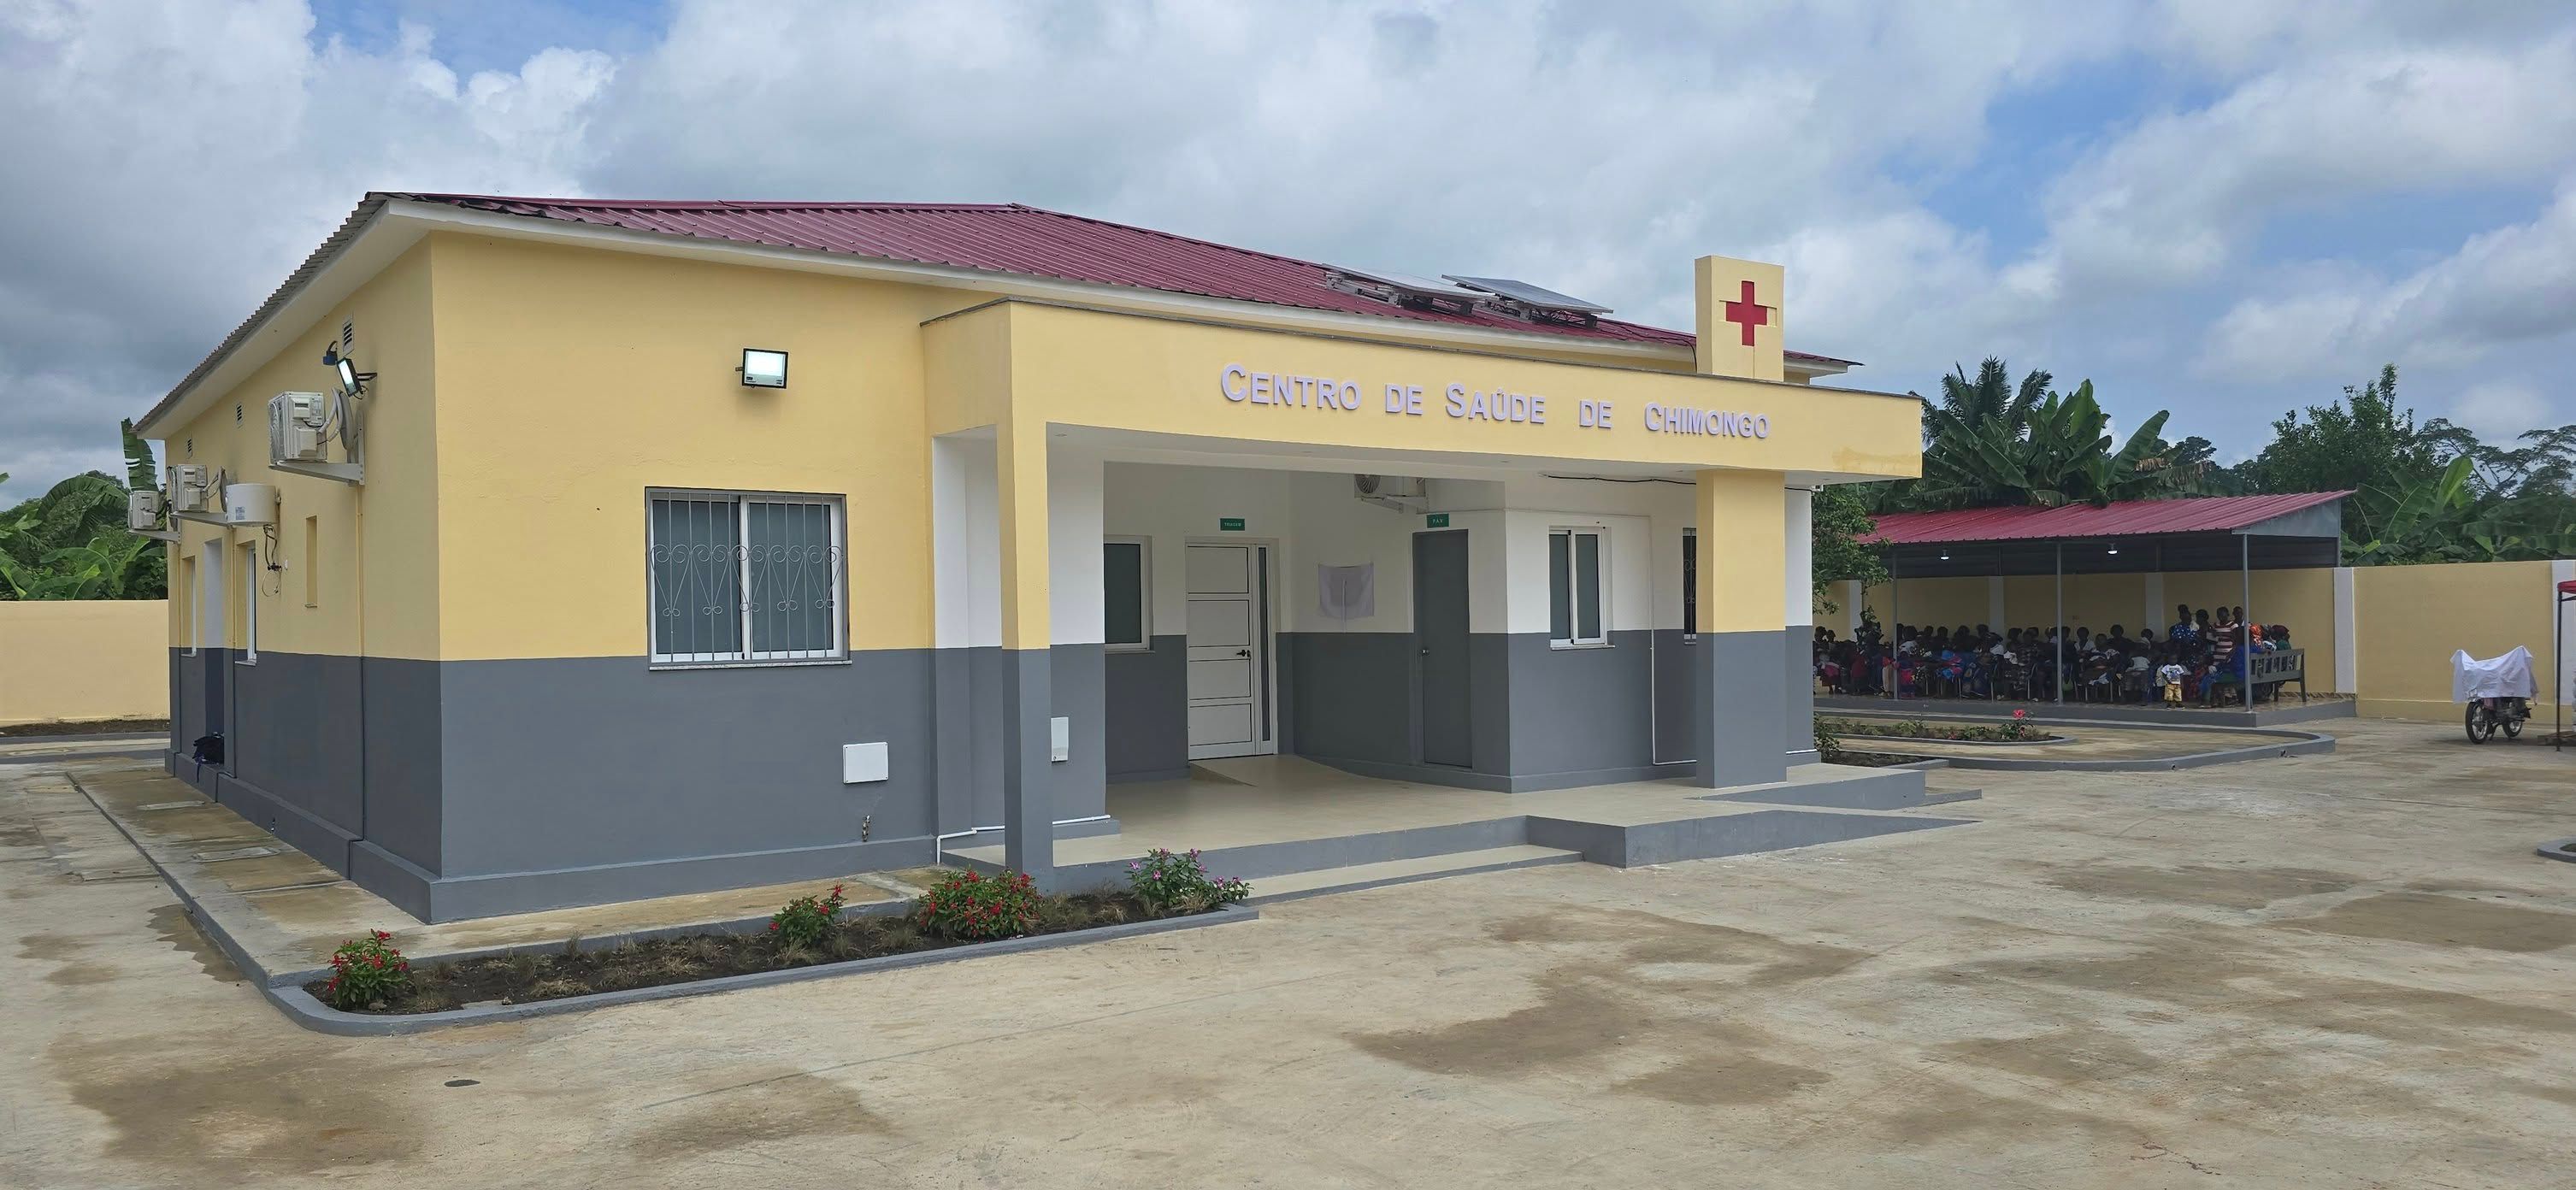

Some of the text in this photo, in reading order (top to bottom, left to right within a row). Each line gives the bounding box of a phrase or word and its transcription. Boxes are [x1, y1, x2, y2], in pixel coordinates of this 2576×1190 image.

[1220, 363, 1771, 439] CENTRO DE SAÚDE DE CHIMONGO
